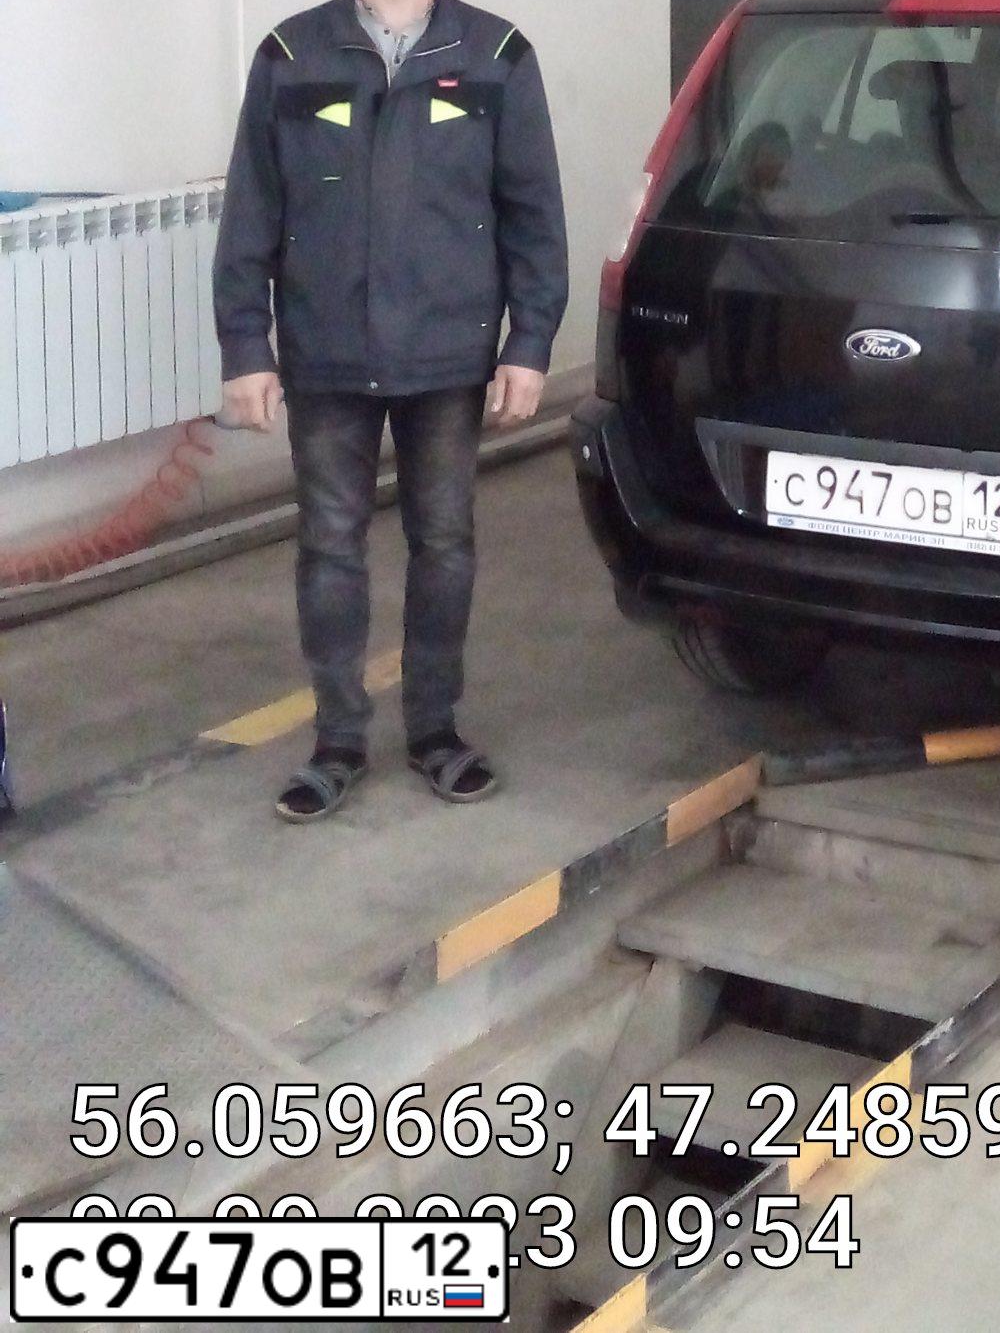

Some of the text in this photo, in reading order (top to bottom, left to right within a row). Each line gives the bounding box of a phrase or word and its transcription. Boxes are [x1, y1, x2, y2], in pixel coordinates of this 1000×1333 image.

[859, 335, 901, 359] Ford
[808, 522, 840, 533] ФОРД
[842, 526, 881, 538] ЦЕНТР
[966, 517, 999, 533] RUS
